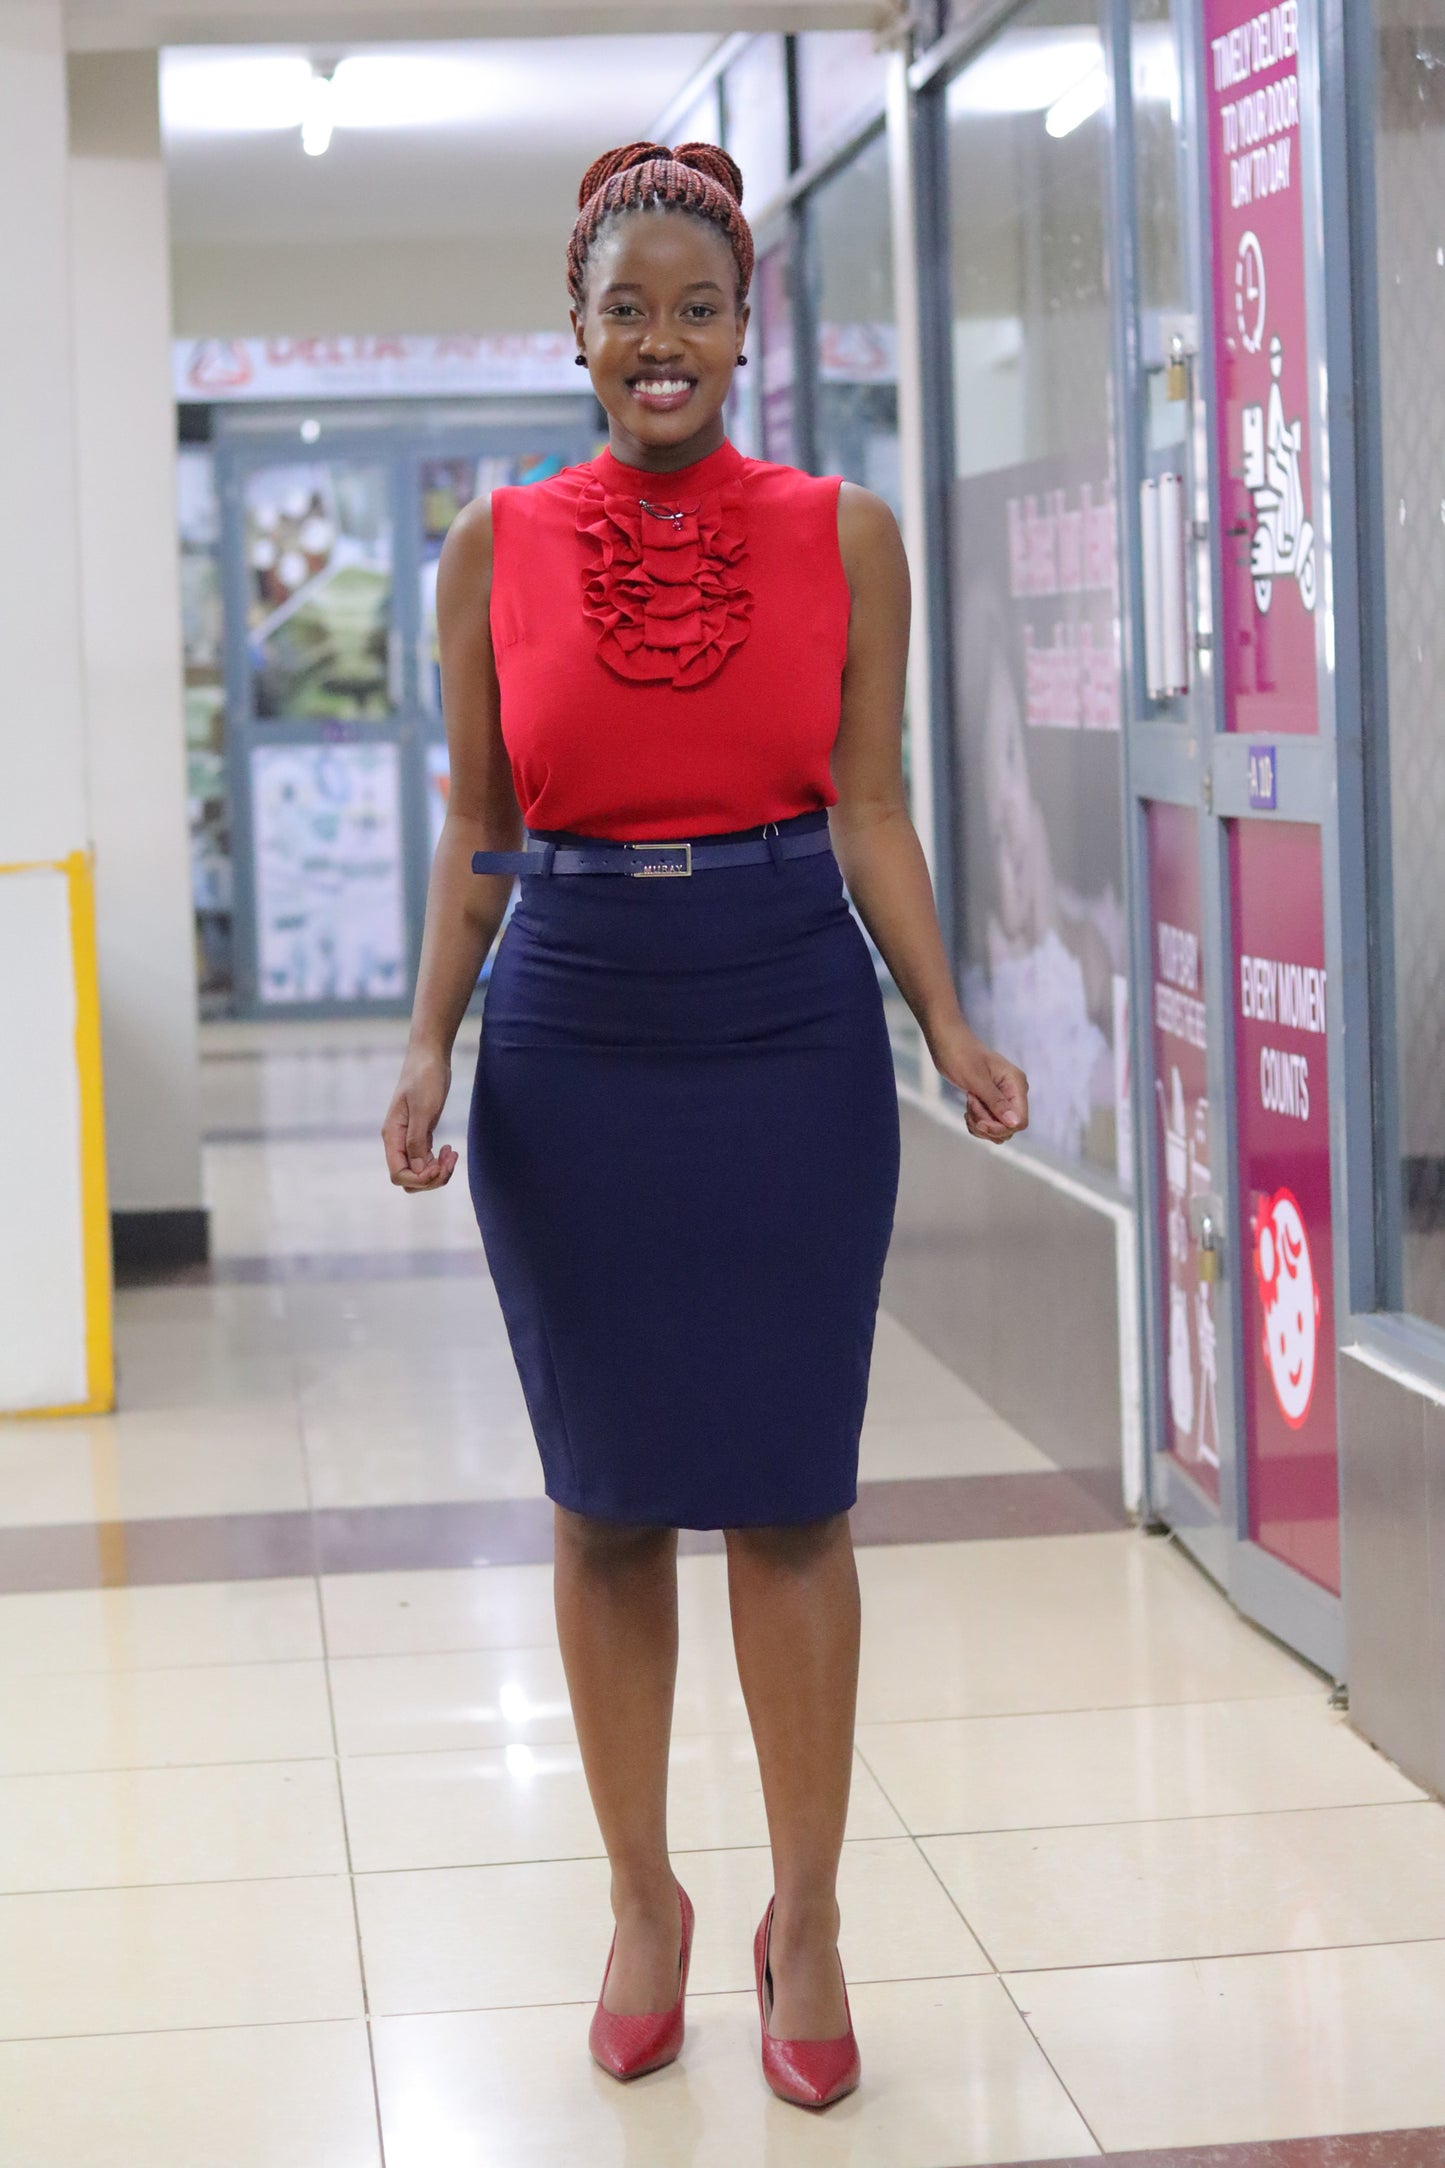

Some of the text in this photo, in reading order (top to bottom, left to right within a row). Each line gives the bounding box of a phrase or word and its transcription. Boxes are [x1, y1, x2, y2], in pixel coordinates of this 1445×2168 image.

[1220, 75, 1299, 155] TO YOUR DOOR
[1230, 137, 1291, 208] DAY TO DAY
[1240, 955, 1277, 1023] EVERY
[1260, 1046, 1309, 1121] COUNTS
